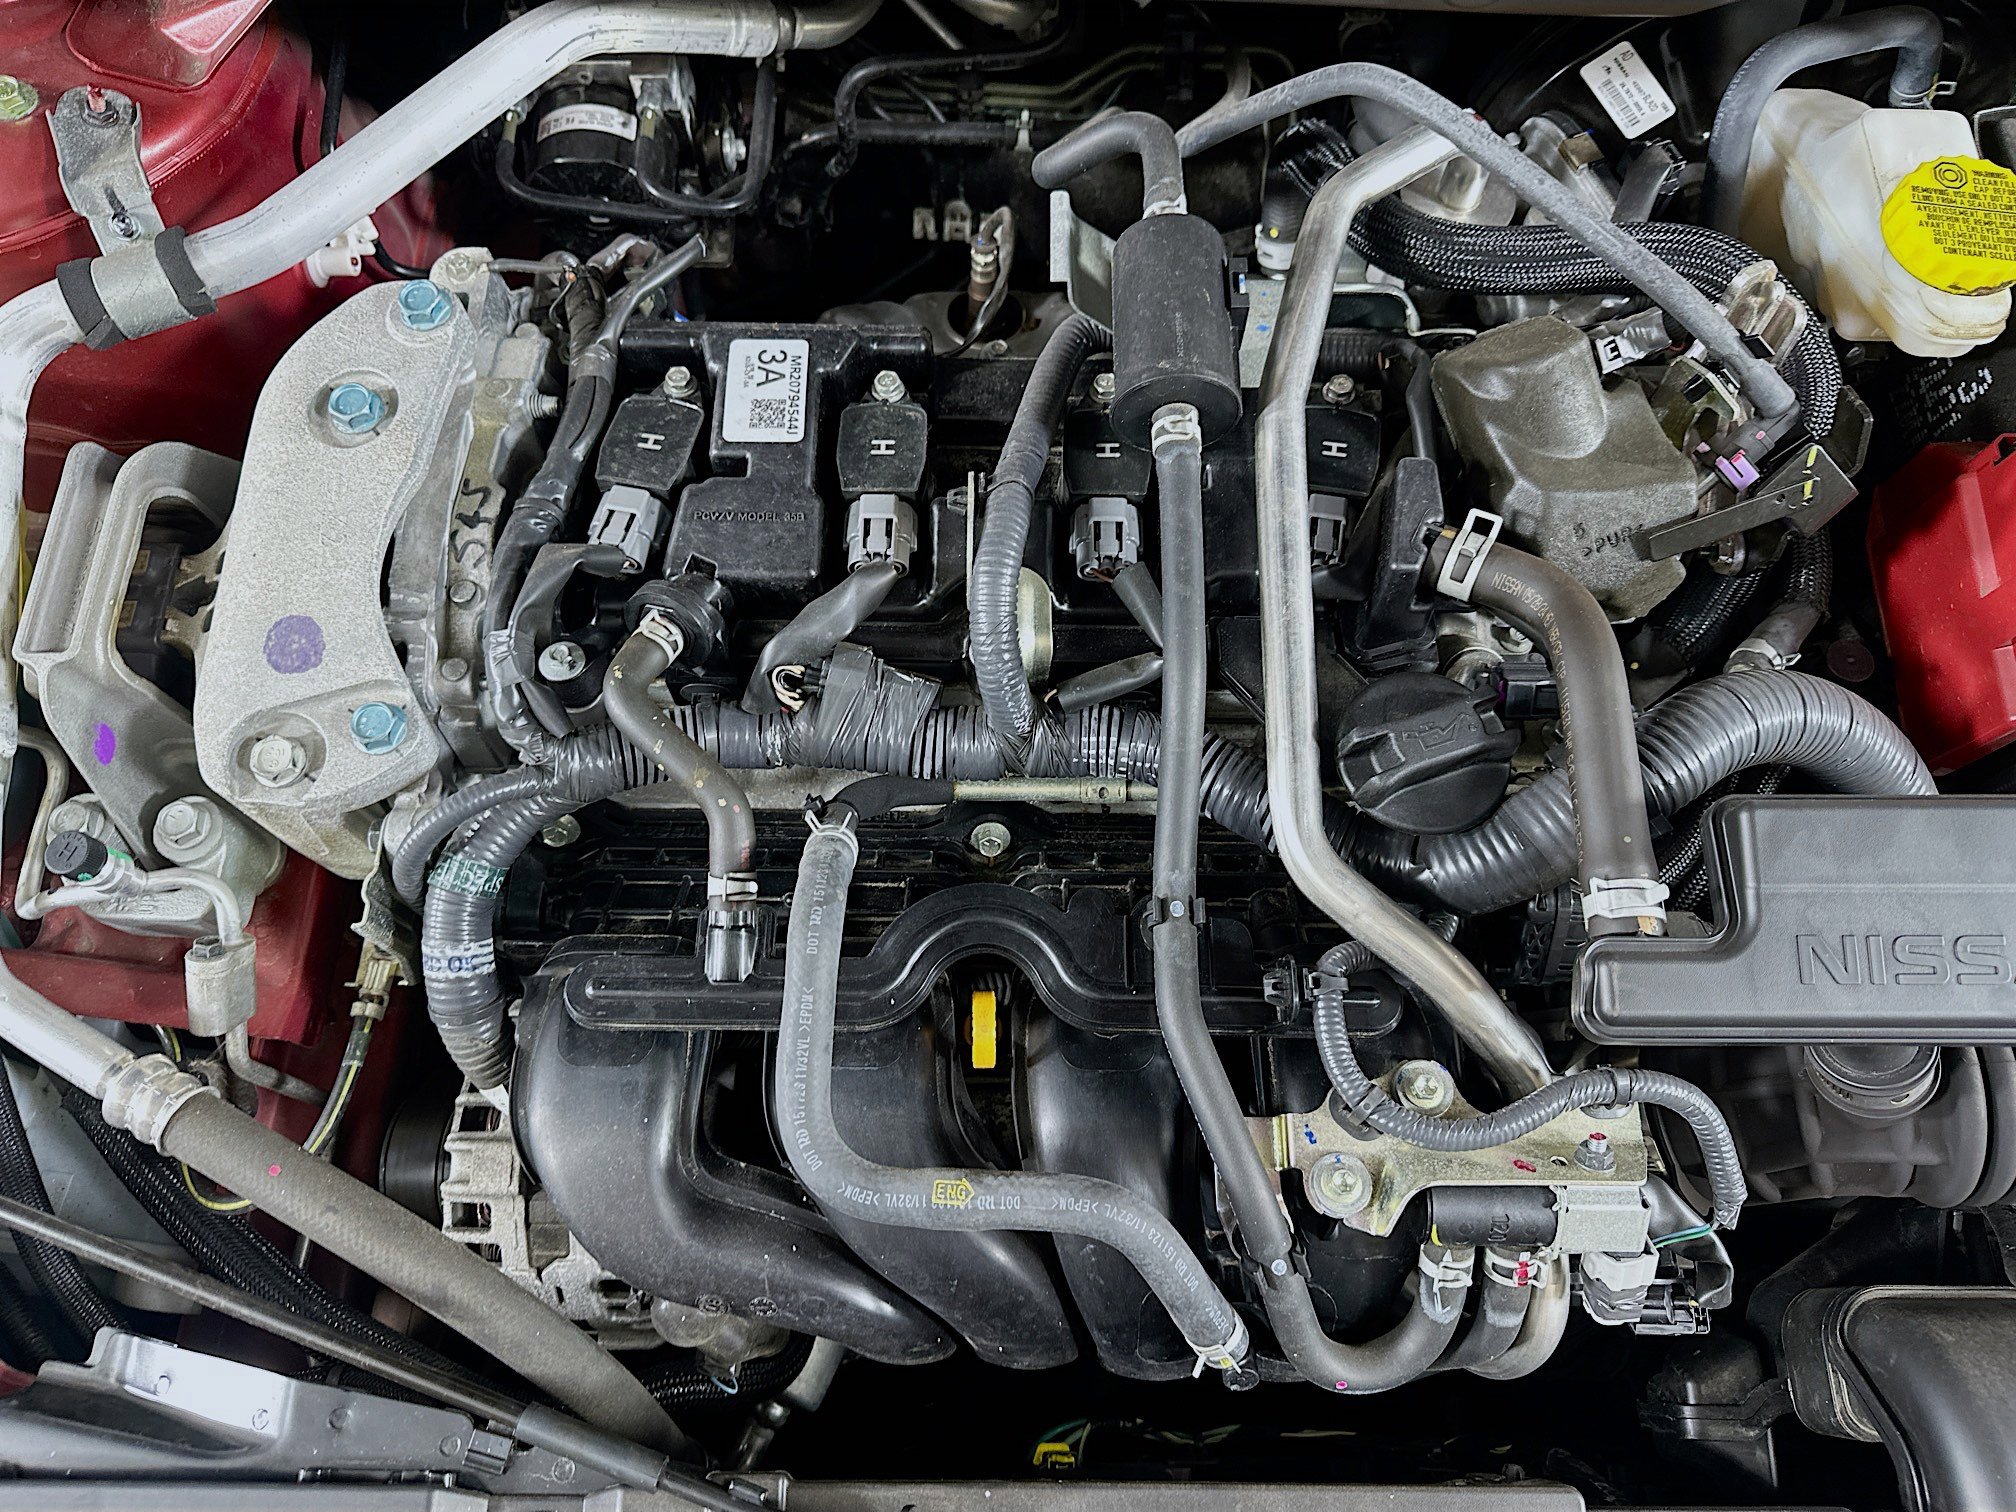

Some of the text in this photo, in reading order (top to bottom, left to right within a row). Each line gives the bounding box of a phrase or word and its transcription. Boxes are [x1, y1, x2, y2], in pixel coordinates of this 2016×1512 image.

[1973, 178, 1998, 187] CLEAN
[1974, 185, 1989, 193] CAP
[1912, 193, 1934, 202] FLUID
[1936, 196, 1957, 205] FROM
[1967, 200, 1998, 210] SEALED
[1968, 192, 1987, 201] ONLY
[1990, 195, 2003, 203] DOT
[1918, 219, 1944, 229] AVANT
[1947, 222, 1957, 231] DE
[1926, 213, 1960, 224] BOUCHON
[1962, 217, 1971, 225] DE
[1932, 229, 1977, 240] SEULEMENT
[1980, 234, 1990, 242] DU
[1933, 237, 1948, 245] DOT
[1950, 238, 1956, 246] 3
[1957, 239, 2002, 250] PROVENANT
[1943, 246, 1988, 258] CONTENANT
[756, 349, 788, 387] 3A
[787, 355, 802, 435] MR20794544J
[637, 433, 666, 451] H
[870, 439, 896, 455] H
[1095, 442, 1121, 458] H
[1321, 440, 1348, 458] H
[738, 509, 779, 521] MODEL
[1491, 571, 1526, 598] NISSAN
[806, 930, 820, 955] DOT
[1796, 934, 2016, 985] NISS
[802, 1149, 824, 1172] DOT
[936, 1182, 967, 1201] ENG
[999, 1195, 1021, 1210] DOT
[1051, 1195, 1100, 1214] >EPDM<
[1182, 1271, 1199, 1293] DOT
